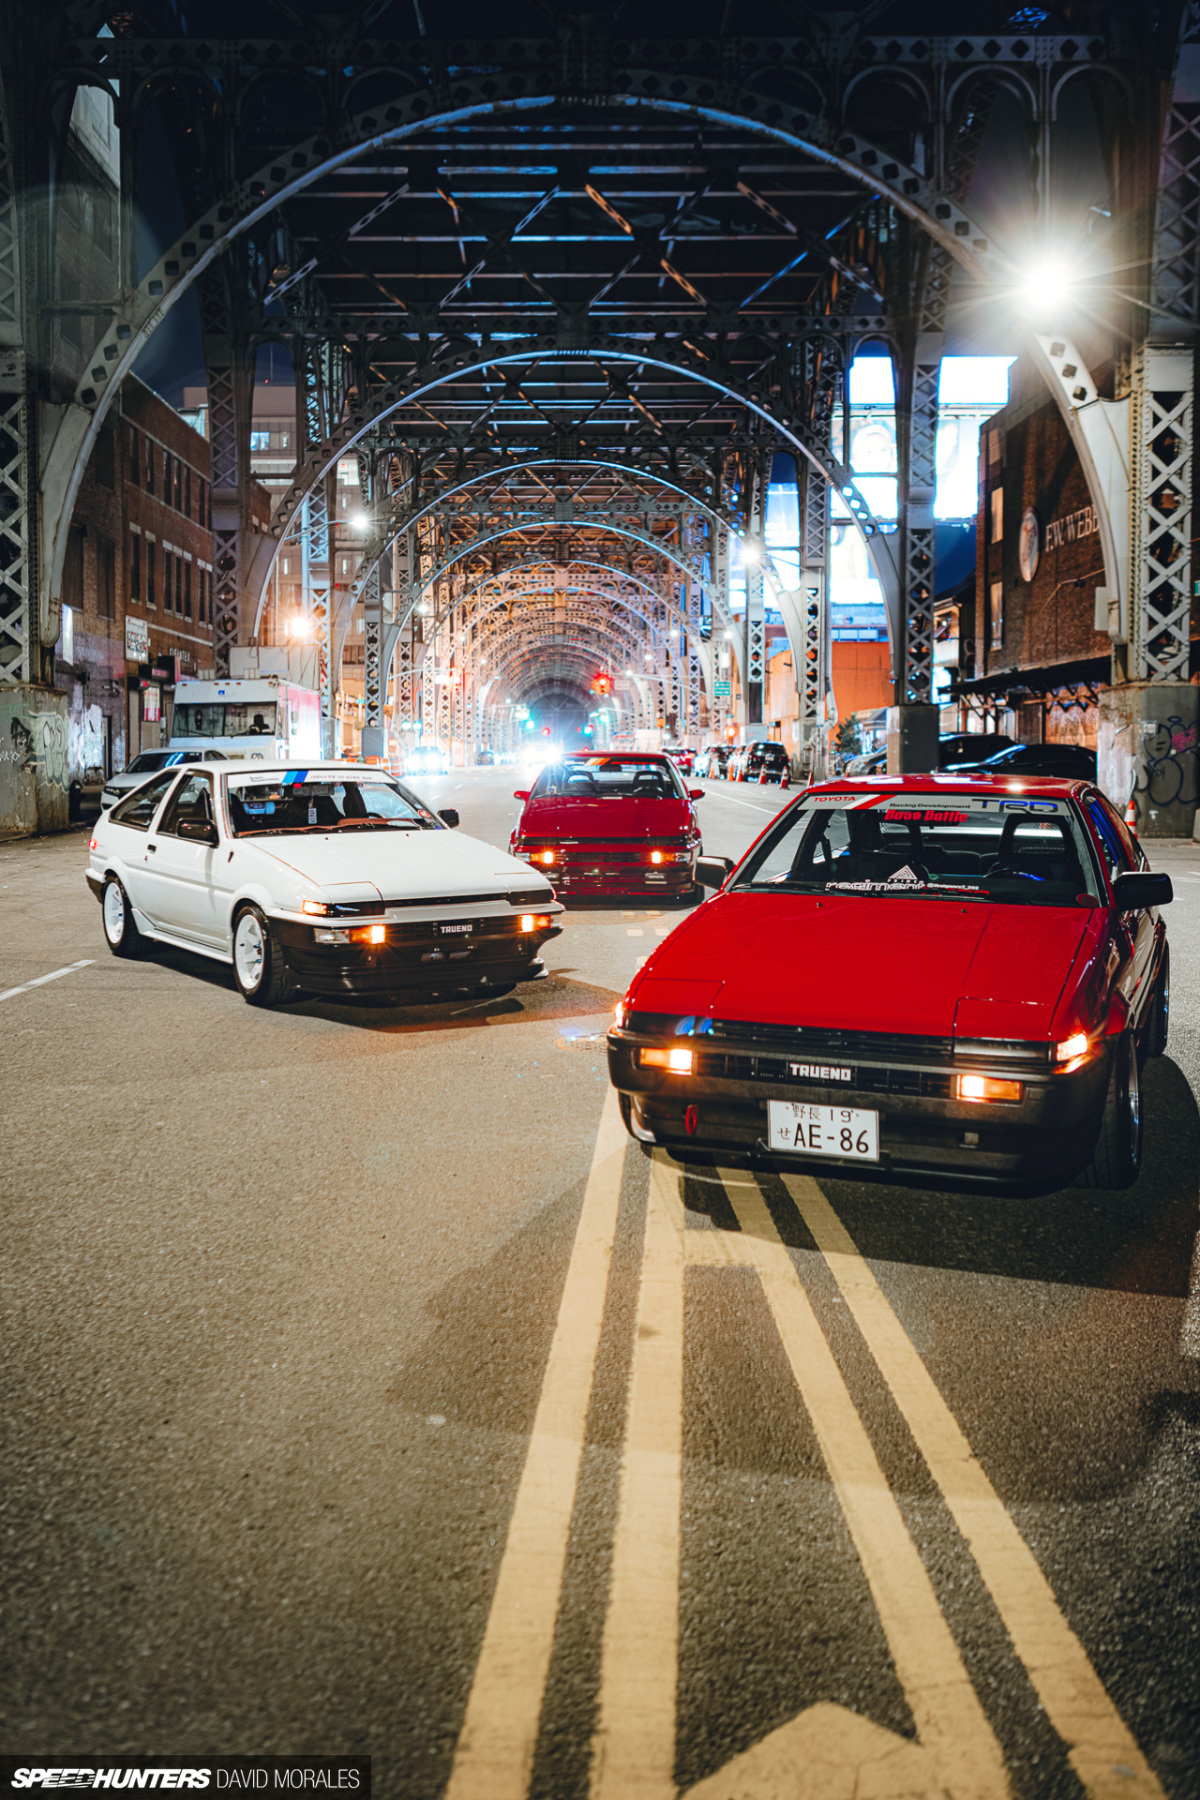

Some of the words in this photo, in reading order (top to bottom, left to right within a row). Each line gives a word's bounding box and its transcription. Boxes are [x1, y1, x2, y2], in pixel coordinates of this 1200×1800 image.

[1045, 518, 1065, 552] F.W.
[972, 799, 1058, 815] TRD
[923, 810, 969, 823] Battle
[440, 924, 473, 934] TRUENO
[789, 1063, 851, 1081] TRUENO
[830, 1109, 852, 1123] 19
[793, 1123, 869, 1154] AE-86
